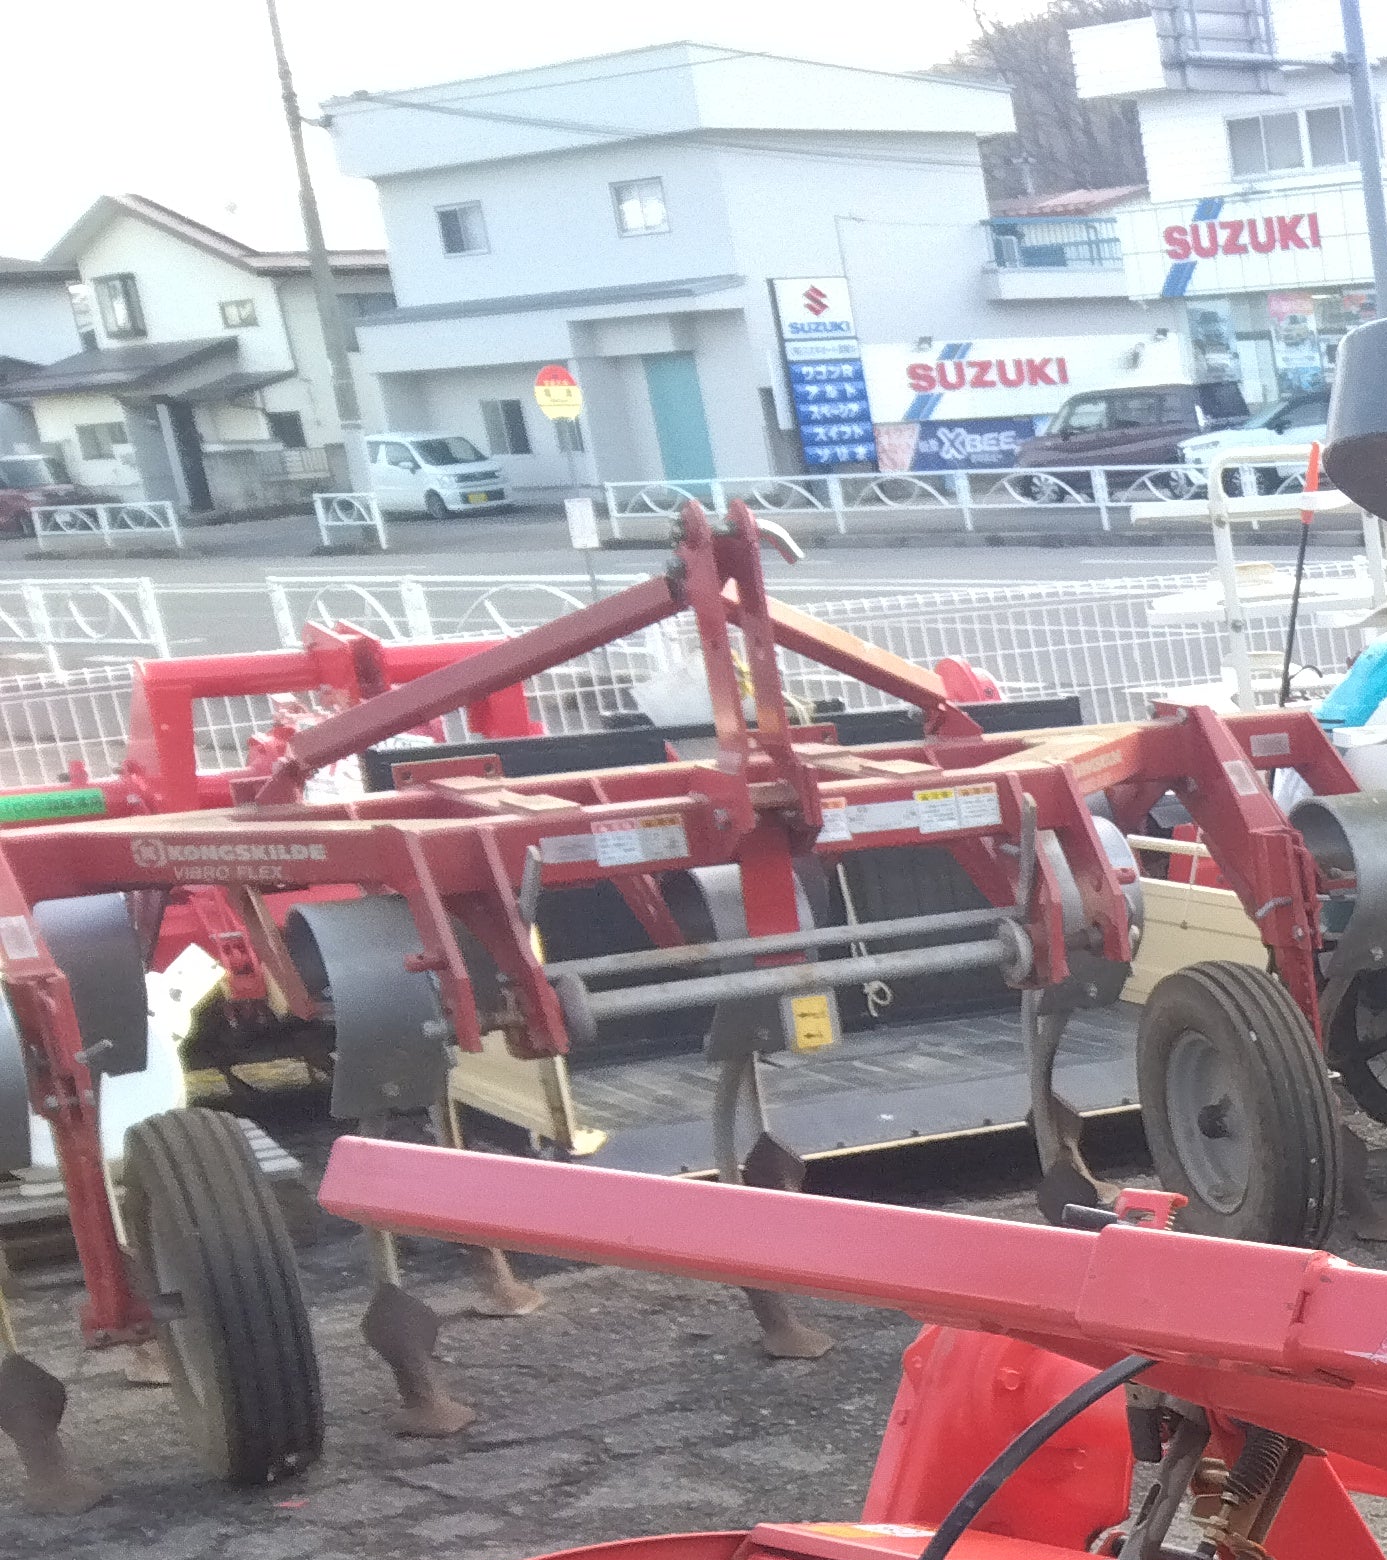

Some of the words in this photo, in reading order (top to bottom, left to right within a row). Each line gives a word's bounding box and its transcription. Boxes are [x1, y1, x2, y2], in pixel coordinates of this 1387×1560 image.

[1163, 212, 1322, 261] SUZUKI
[788, 321, 850, 334] SUZUKI
[906, 357, 1069, 392] SUZUKI
[167, 844, 327, 861] KONGSKILDE
